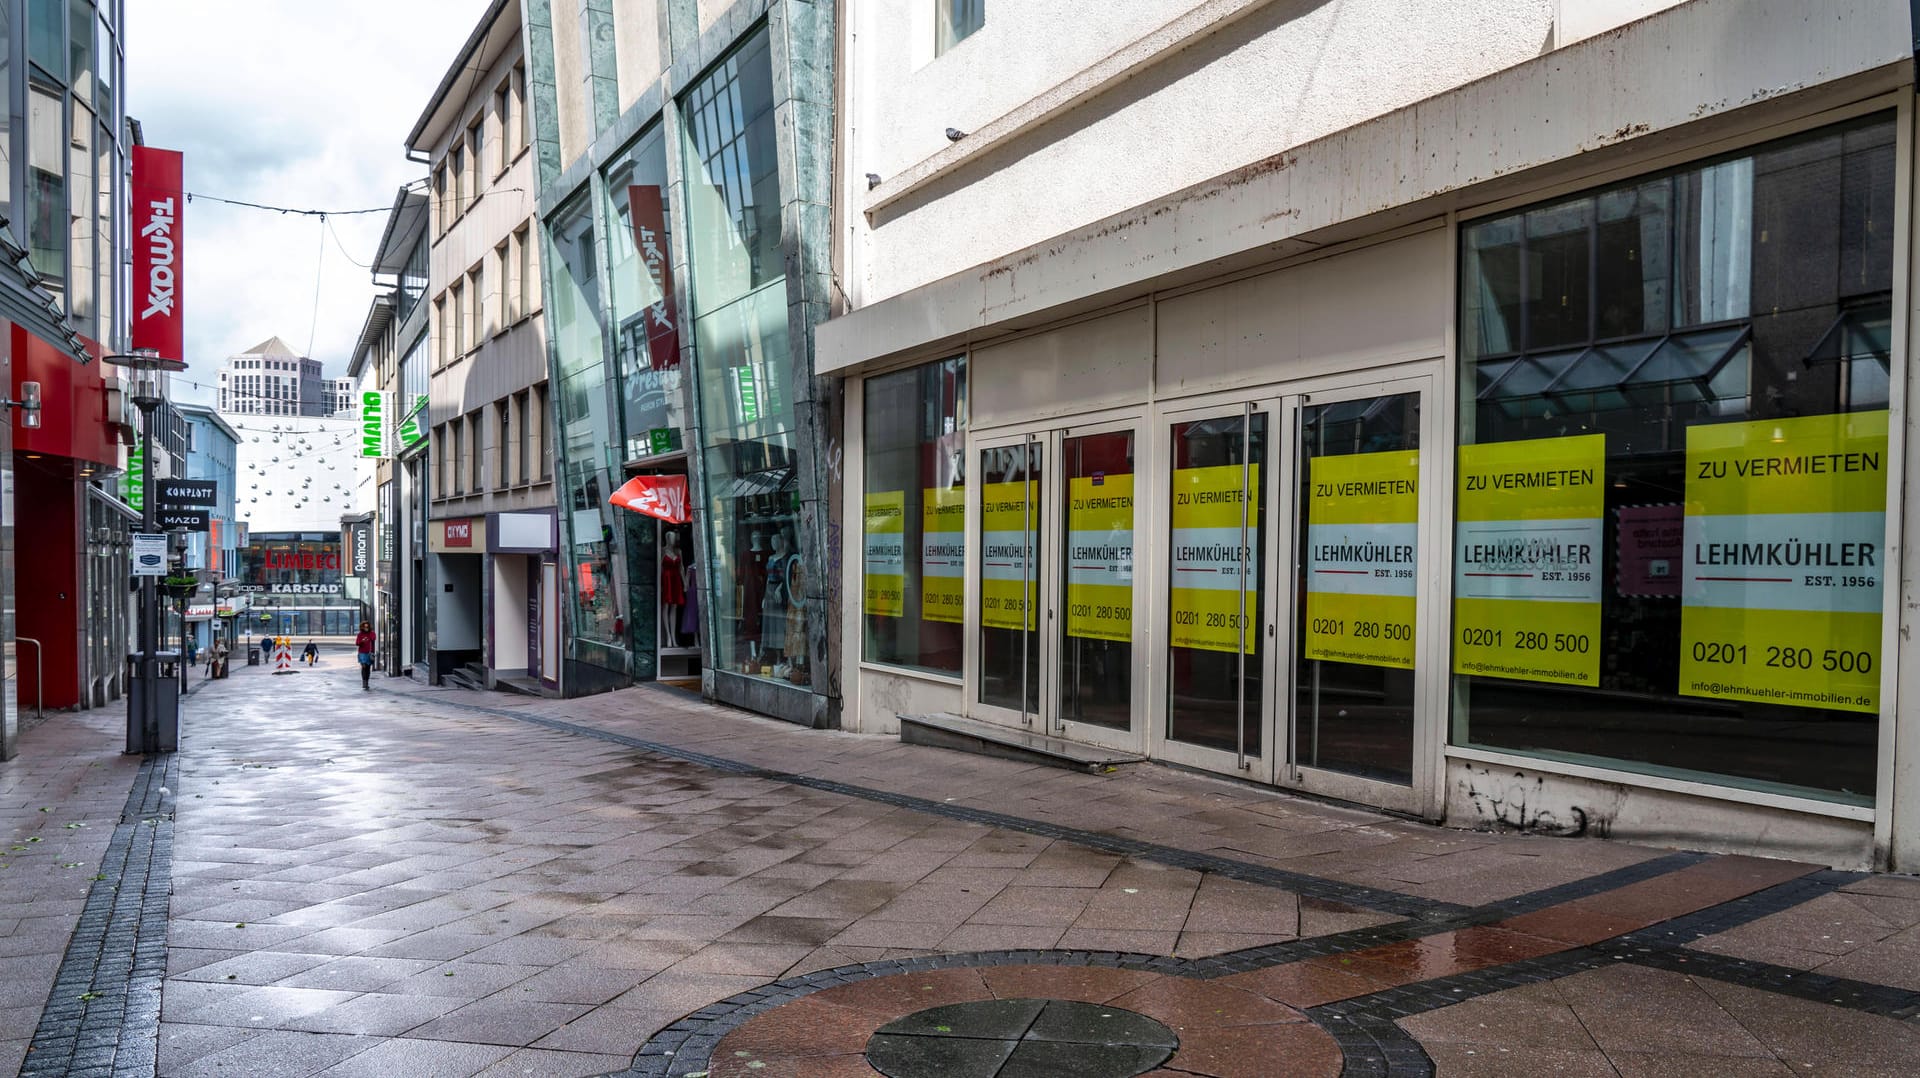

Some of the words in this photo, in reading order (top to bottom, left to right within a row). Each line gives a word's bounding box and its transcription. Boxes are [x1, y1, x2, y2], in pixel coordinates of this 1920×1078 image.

[1698, 461, 1726, 479] ZU
[1735, 452, 1879, 477] VERMIETEN
[1466, 475, 1487, 490] ZU
[1492, 469, 1593, 489] VERMIETEN
[1316, 484, 1333, 497] ZU
[1337, 480, 1415, 496] VERMIETEN
[1073, 499, 1084, 510] ZU
[1086, 496, 1133, 509] VERMIETEN
[1177, 493, 1190, 504] ZU
[986, 503, 994, 512] ZU
[165, 516, 200, 524] MAZO
[1072, 544, 1132, 560] LEHMKÜHLER
[1314, 542, 1413, 563] LEHMKÜHLER
[1464, 540, 1591, 564] LEHMKÜHLER
[1695, 538, 1875, 567] LEHMKÜHLER
[1221, 567, 1236, 575] EST.
[1375, 569, 1392, 578] EST.
[1394, 569, 1412, 578] 1956
[1542, 572, 1565, 582] EST.
[1568, 571, 1591, 582] 1956
[271, 583, 343, 593] KARSTAD
[1804, 576, 1836, 587] EST.
[1842, 576, 1875, 587] 1956
[1005, 599, 1017, 610] 280
[1072, 604, 1091, 617] 0201
[1096, 605, 1112, 619] 280
[1115, 607, 1131, 620] 500
[1176, 611, 1199, 625] 0201
[1206, 612, 1226, 627] 280
[1312, 619, 1345, 636] 0201
[1353, 621, 1379, 639] 280
[1384, 624, 1411, 641] 500
[1463, 628, 1503, 647] 0201
[1515, 631, 1548, 650] 280
[1554, 634, 1589, 653] 500
[1692, 642, 1748, 665] 0201
[1766, 646, 1812, 669] 280
[1822, 650, 1872, 673] 500
[1462, 662, 1588, 681] info@lehmkuehler-immobilien.de
[1691, 681, 1871, 706] info@lehmkuehler-immobilien.de
